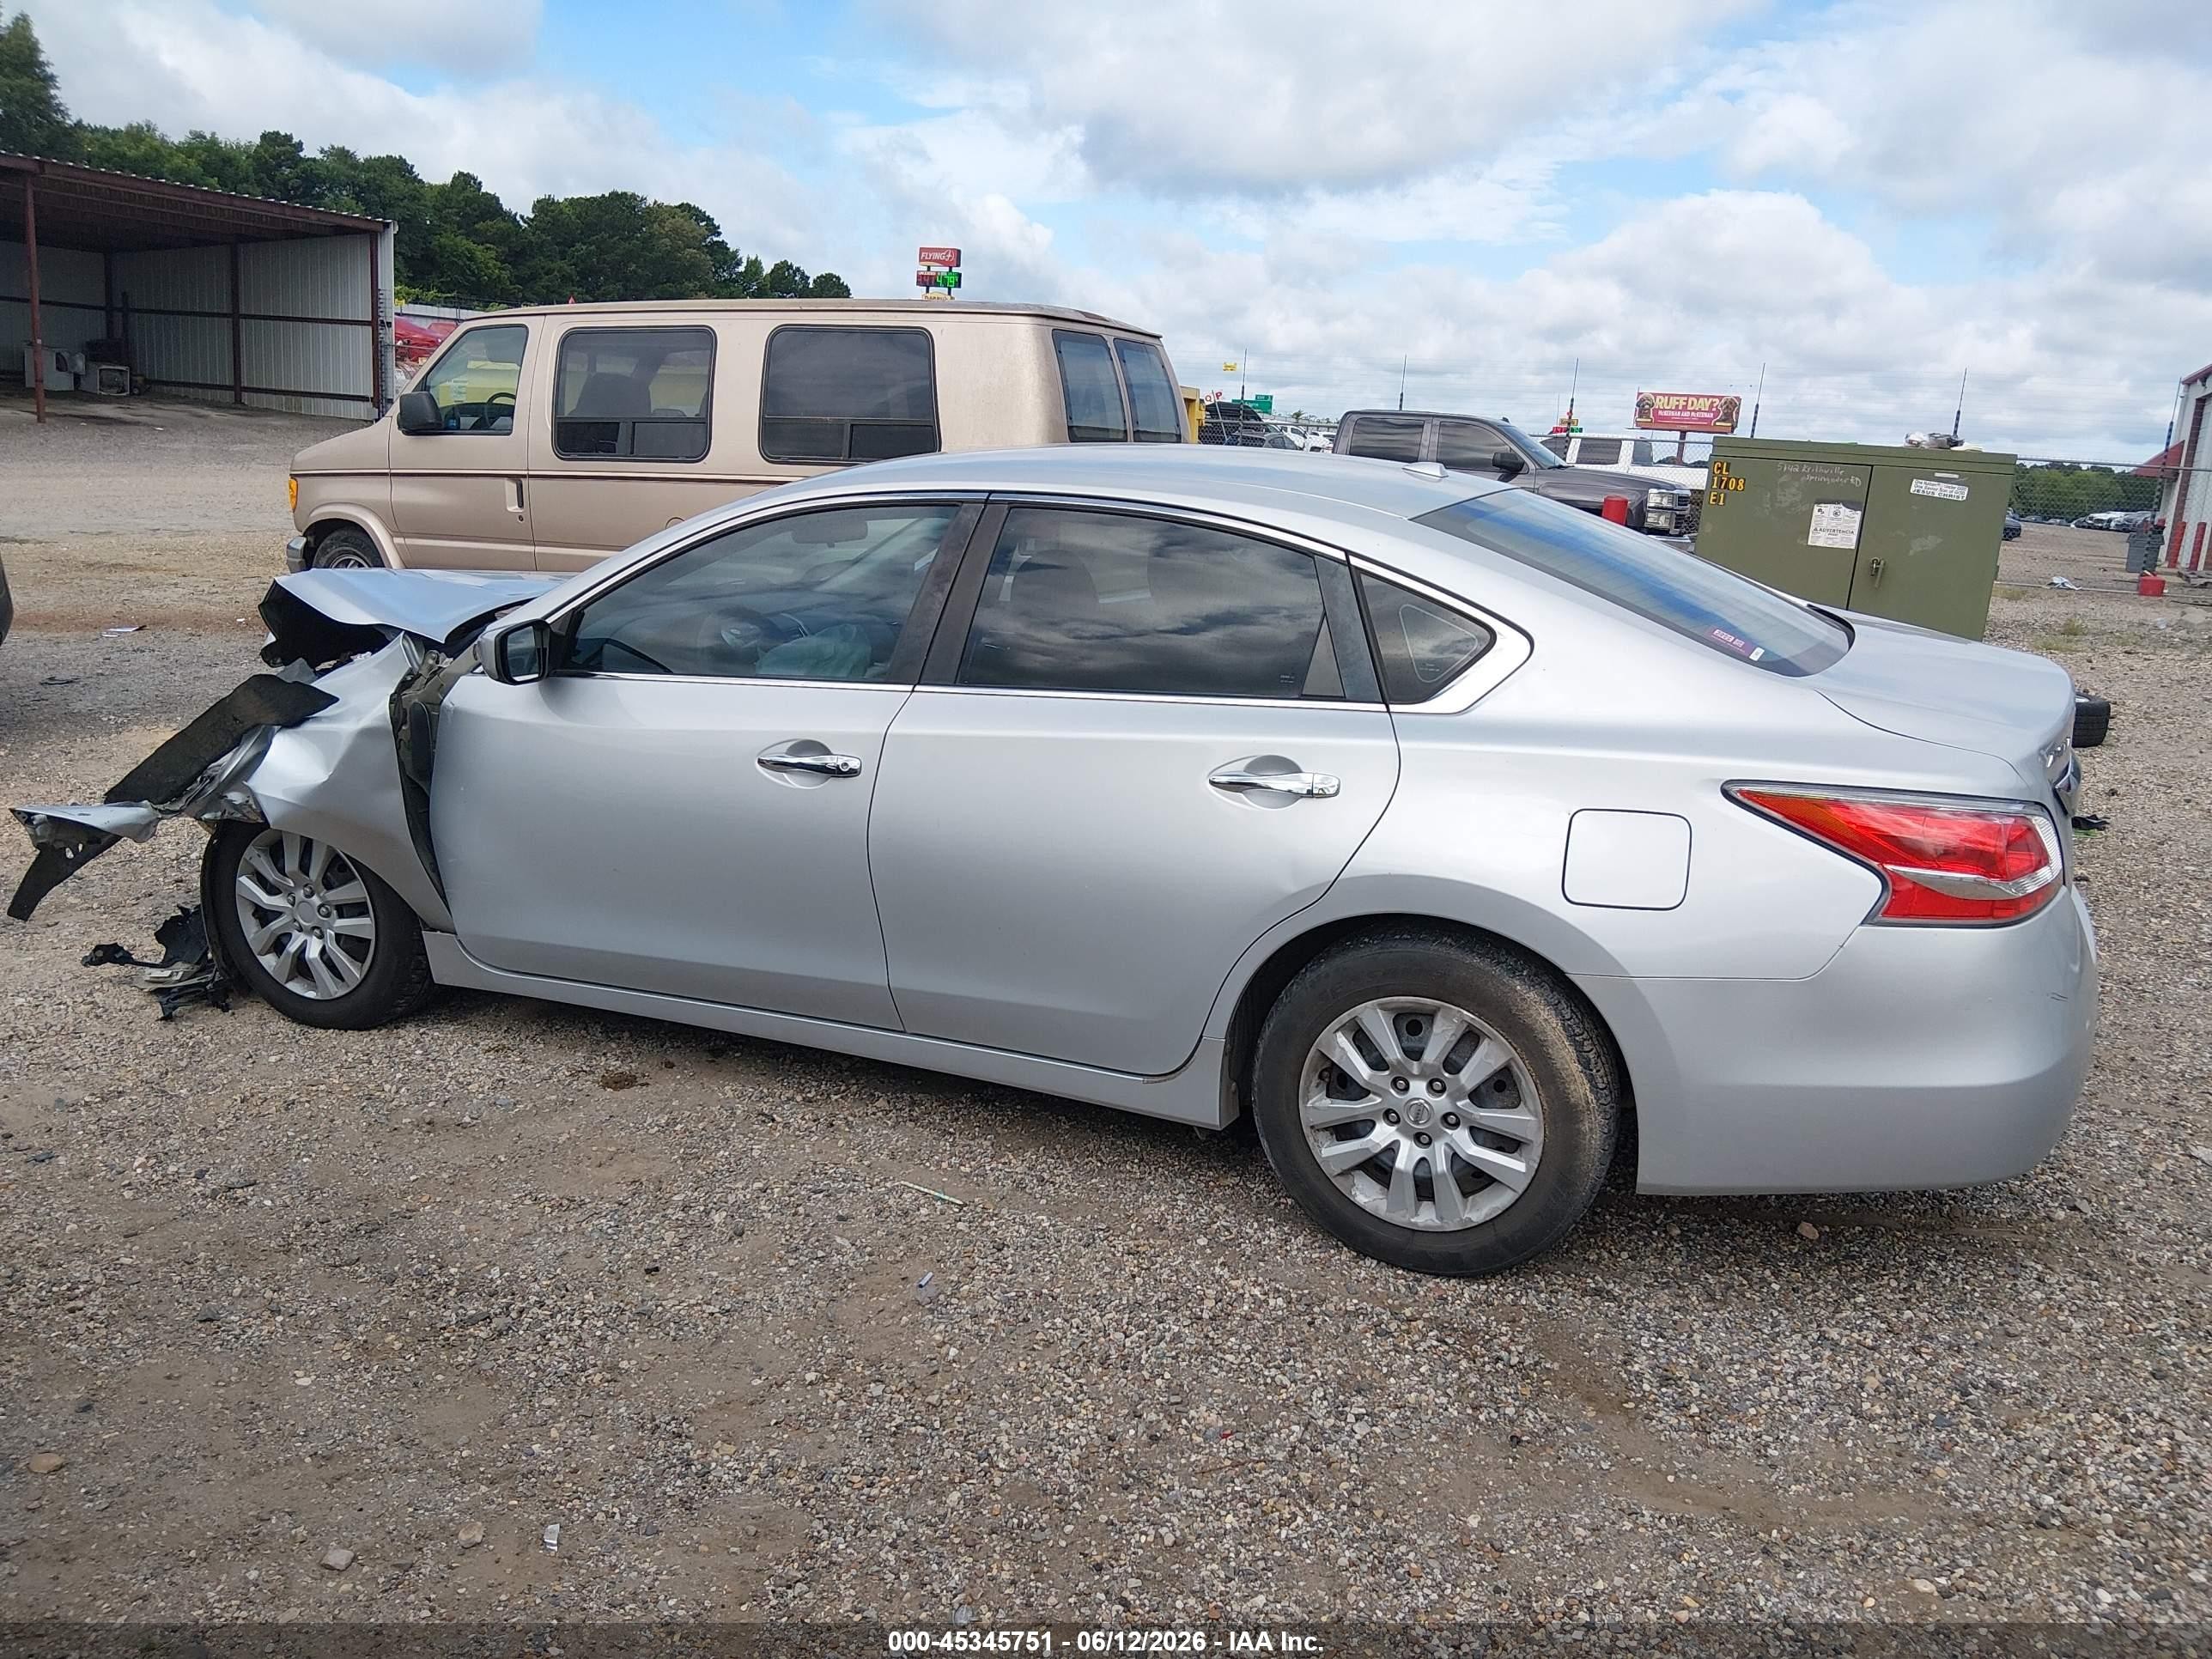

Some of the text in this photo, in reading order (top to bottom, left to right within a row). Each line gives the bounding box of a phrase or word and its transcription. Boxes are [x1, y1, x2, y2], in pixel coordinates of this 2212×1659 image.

[1655, 395, 1718, 411] RUFF DAY?
[1714, 462, 1729, 475] CL
[1711, 477, 1744, 490] 1708
[1710, 492, 1724, 506] E1
